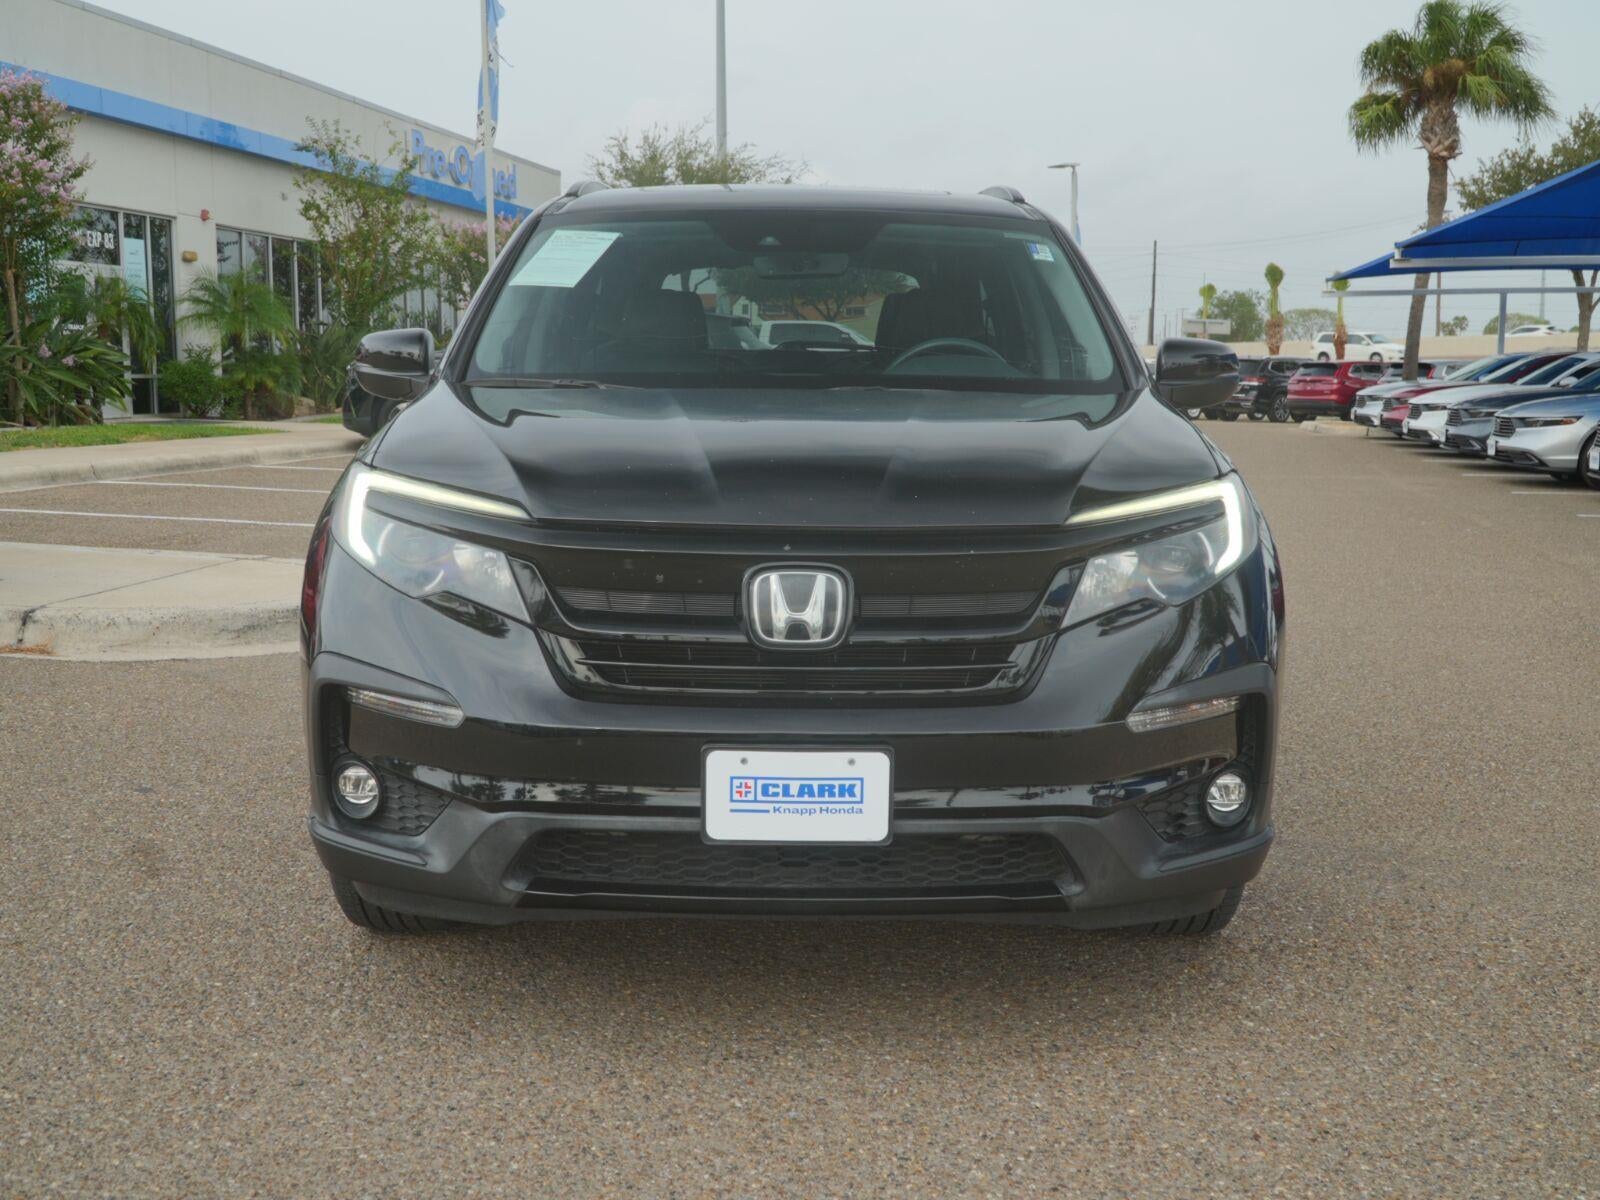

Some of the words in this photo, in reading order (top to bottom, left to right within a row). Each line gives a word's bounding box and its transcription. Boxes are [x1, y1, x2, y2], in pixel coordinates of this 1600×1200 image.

[410, 128, 517, 199] Pre-Oed
[86, 230, 102, 248] EXP
[103, 232, 115, 249] 83
[760, 782, 858, 799] CLARK
[772, 805, 818, 817] Knapp
[819, 805, 864, 815] Honda
